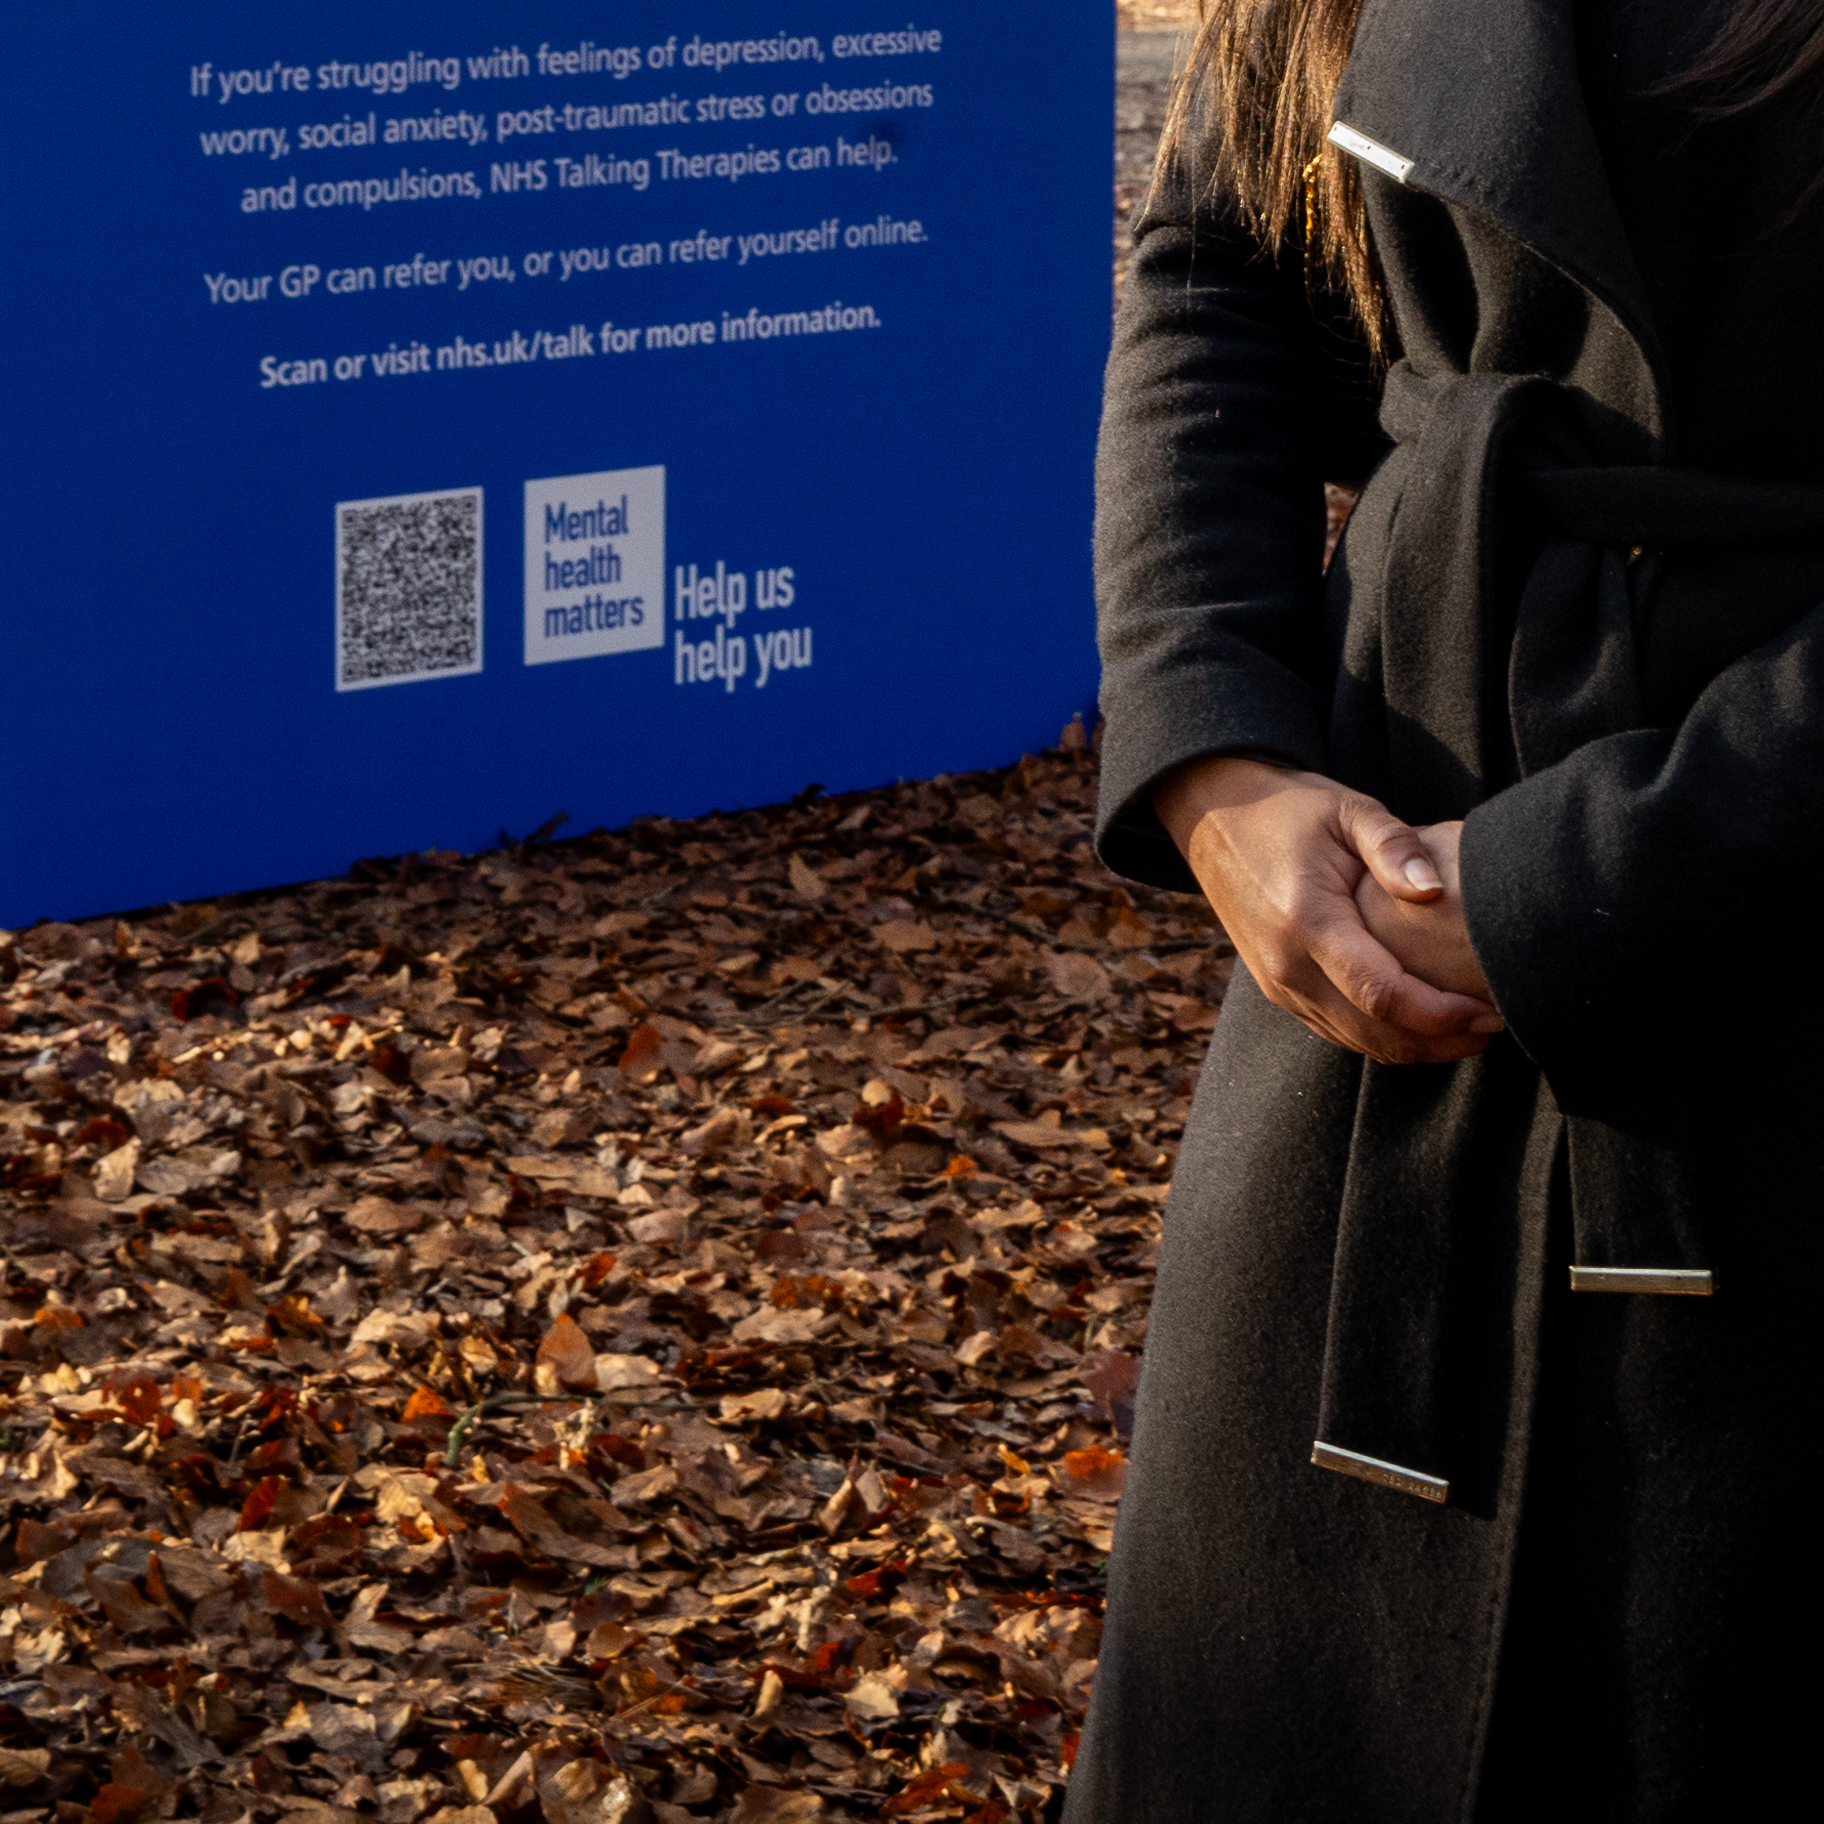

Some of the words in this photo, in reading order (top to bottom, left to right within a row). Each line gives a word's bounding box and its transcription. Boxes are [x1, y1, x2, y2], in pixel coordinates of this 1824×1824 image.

[190, 61, 213, 98] If
[316, 50, 461, 96] struggling
[466, 44, 530, 81] with
[536, 41, 643, 81] feelings
[646, 34, 677, 70] of
[681, 30, 825, 72] depression,
[831, 23, 943, 59] excessive
[199, 126, 291, 162] worry,
[298, 111, 377, 151] social
[382, 107, 489, 147] anxiety,
[496, 92, 691, 145] post-traumatic
[695, 93, 767, 124] stress
[770, 91, 800, 118] or
[804, 79, 934, 116] obsessions
[240, 175, 297, 215] and
[303, 166, 482, 212] compulsions,
[490, 158, 549, 193] NHS
[553, 153, 651, 192] Talking
[655, 143, 782, 183] Therapies
[785, 144, 831, 172] can
[836, 135, 898, 172] help.
[203, 272, 273, 305] Your
[278, 262, 321, 300] GP
[325, 265, 377, 295] can
[383, 251, 452, 289] refer
[456, 255, 516, 292] you,
[522, 250, 554, 278] or
[559, 247, 610, 283] you
[615, 241, 663, 270] can
[668, 228, 733, 264] refer
[737, 216, 840, 266] yourself
[843, 214, 928, 250] online.
[259, 354, 328, 390] Scan
[333, 353, 367, 382] or
[371, 340, 431, 377] visit
[436, 324, 595, 371] nhs.uk/talk
[599, 320, 642, 354] for
[645, 319, 717, 350] more
[721, 300, 882, 343] information.
[543, 494, 629, 544] Mental
[543, 542, 621, 591] health
[674, 560, 747, 628] Help
[755, 565, 795, 611] us
[544, 591, 645, 638] matters
[674, 625, 747, 693] help
[753, 626, 813, 689] you
